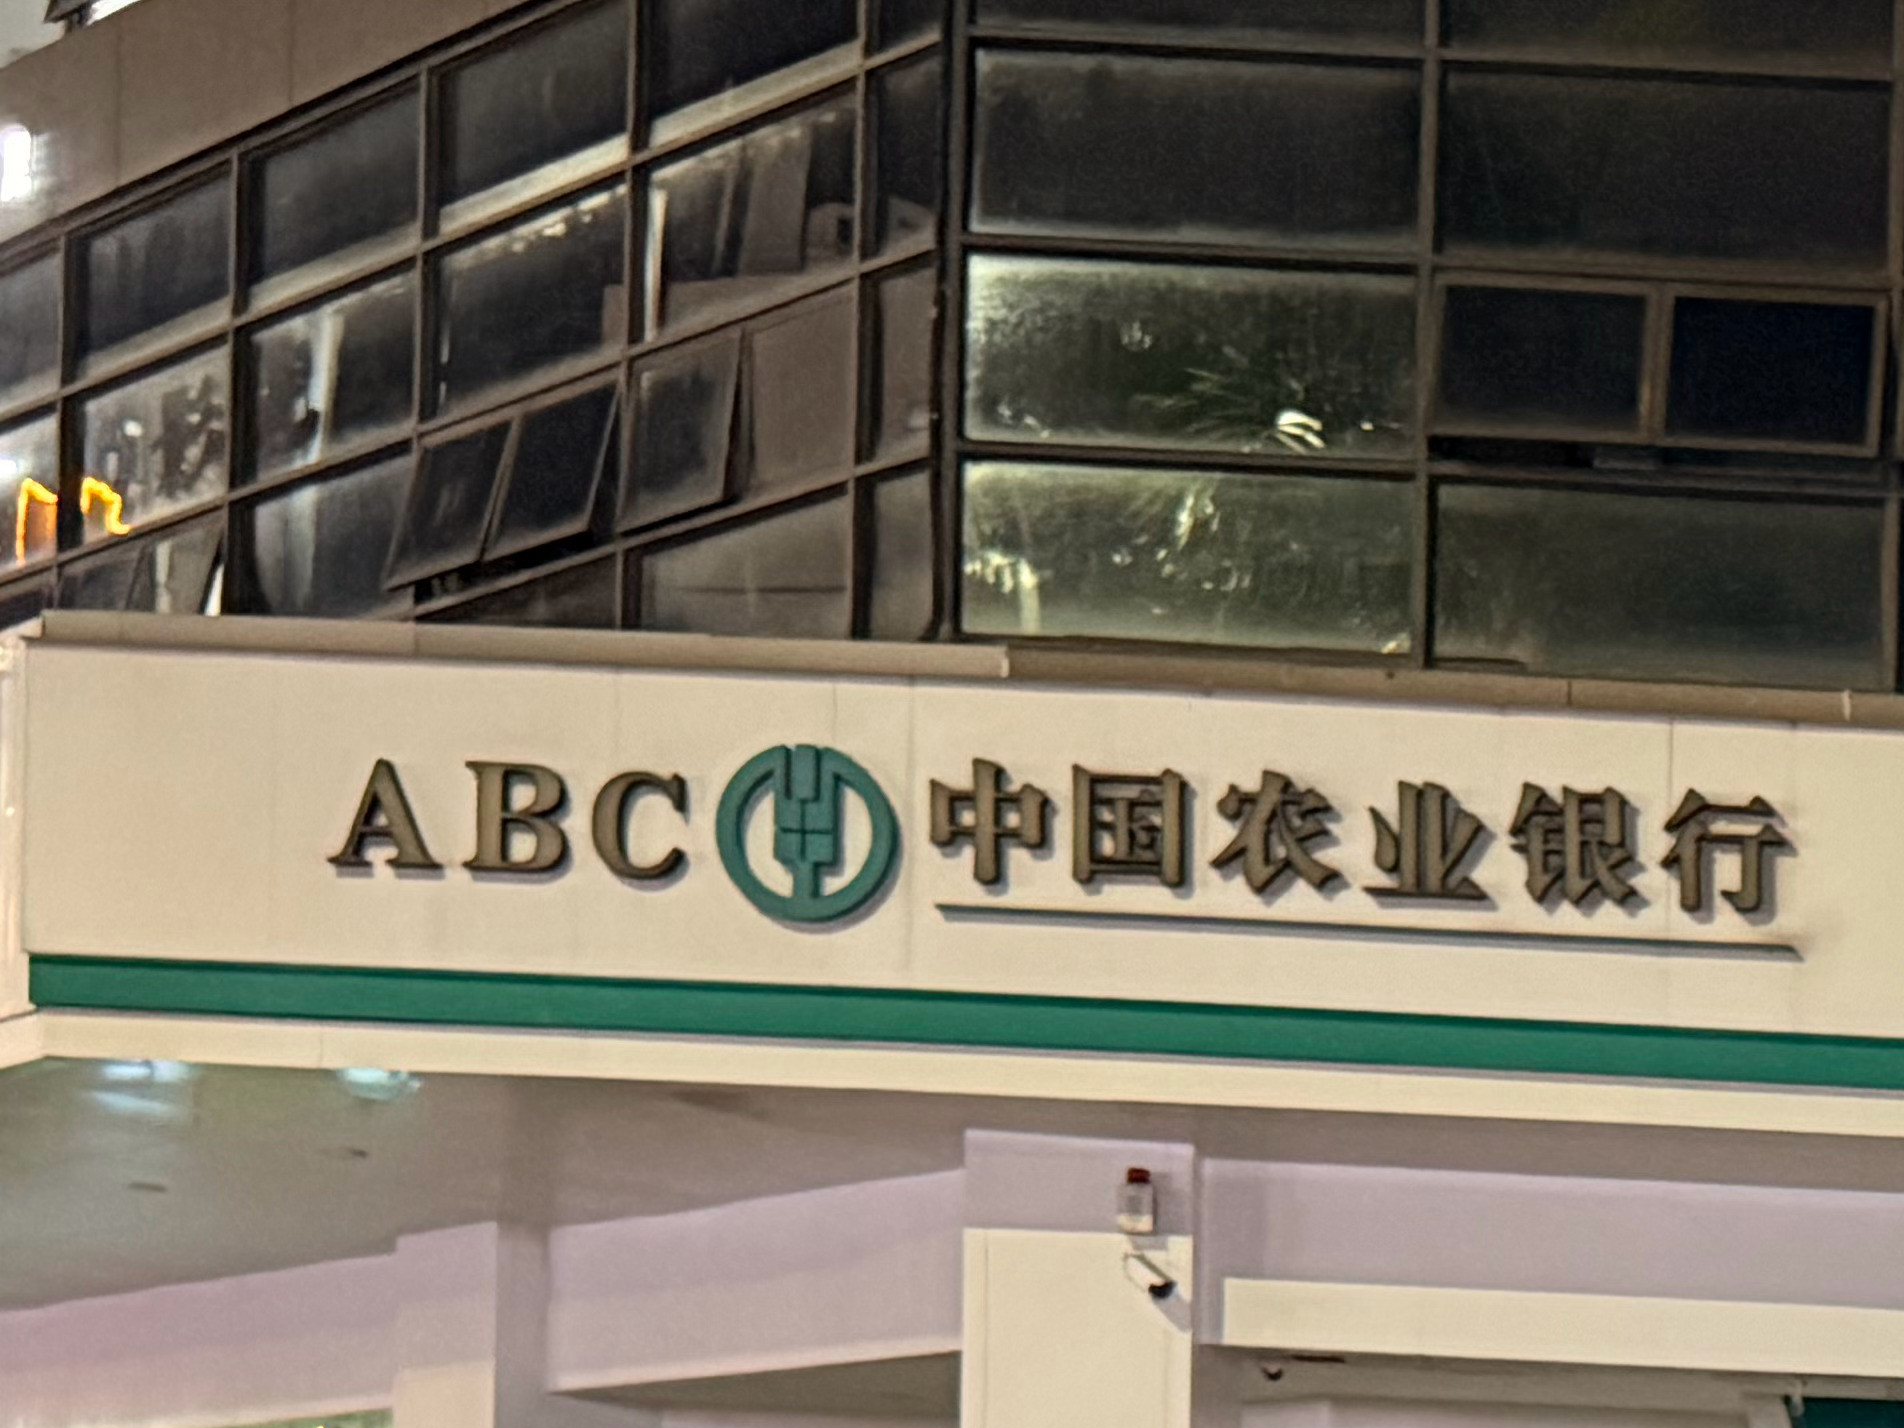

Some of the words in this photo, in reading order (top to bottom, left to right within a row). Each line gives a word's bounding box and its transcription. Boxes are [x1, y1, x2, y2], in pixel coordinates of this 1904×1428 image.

[327, 758, 690, 880] ABC
[929, 757, 1797, 913] 中国农业银行
